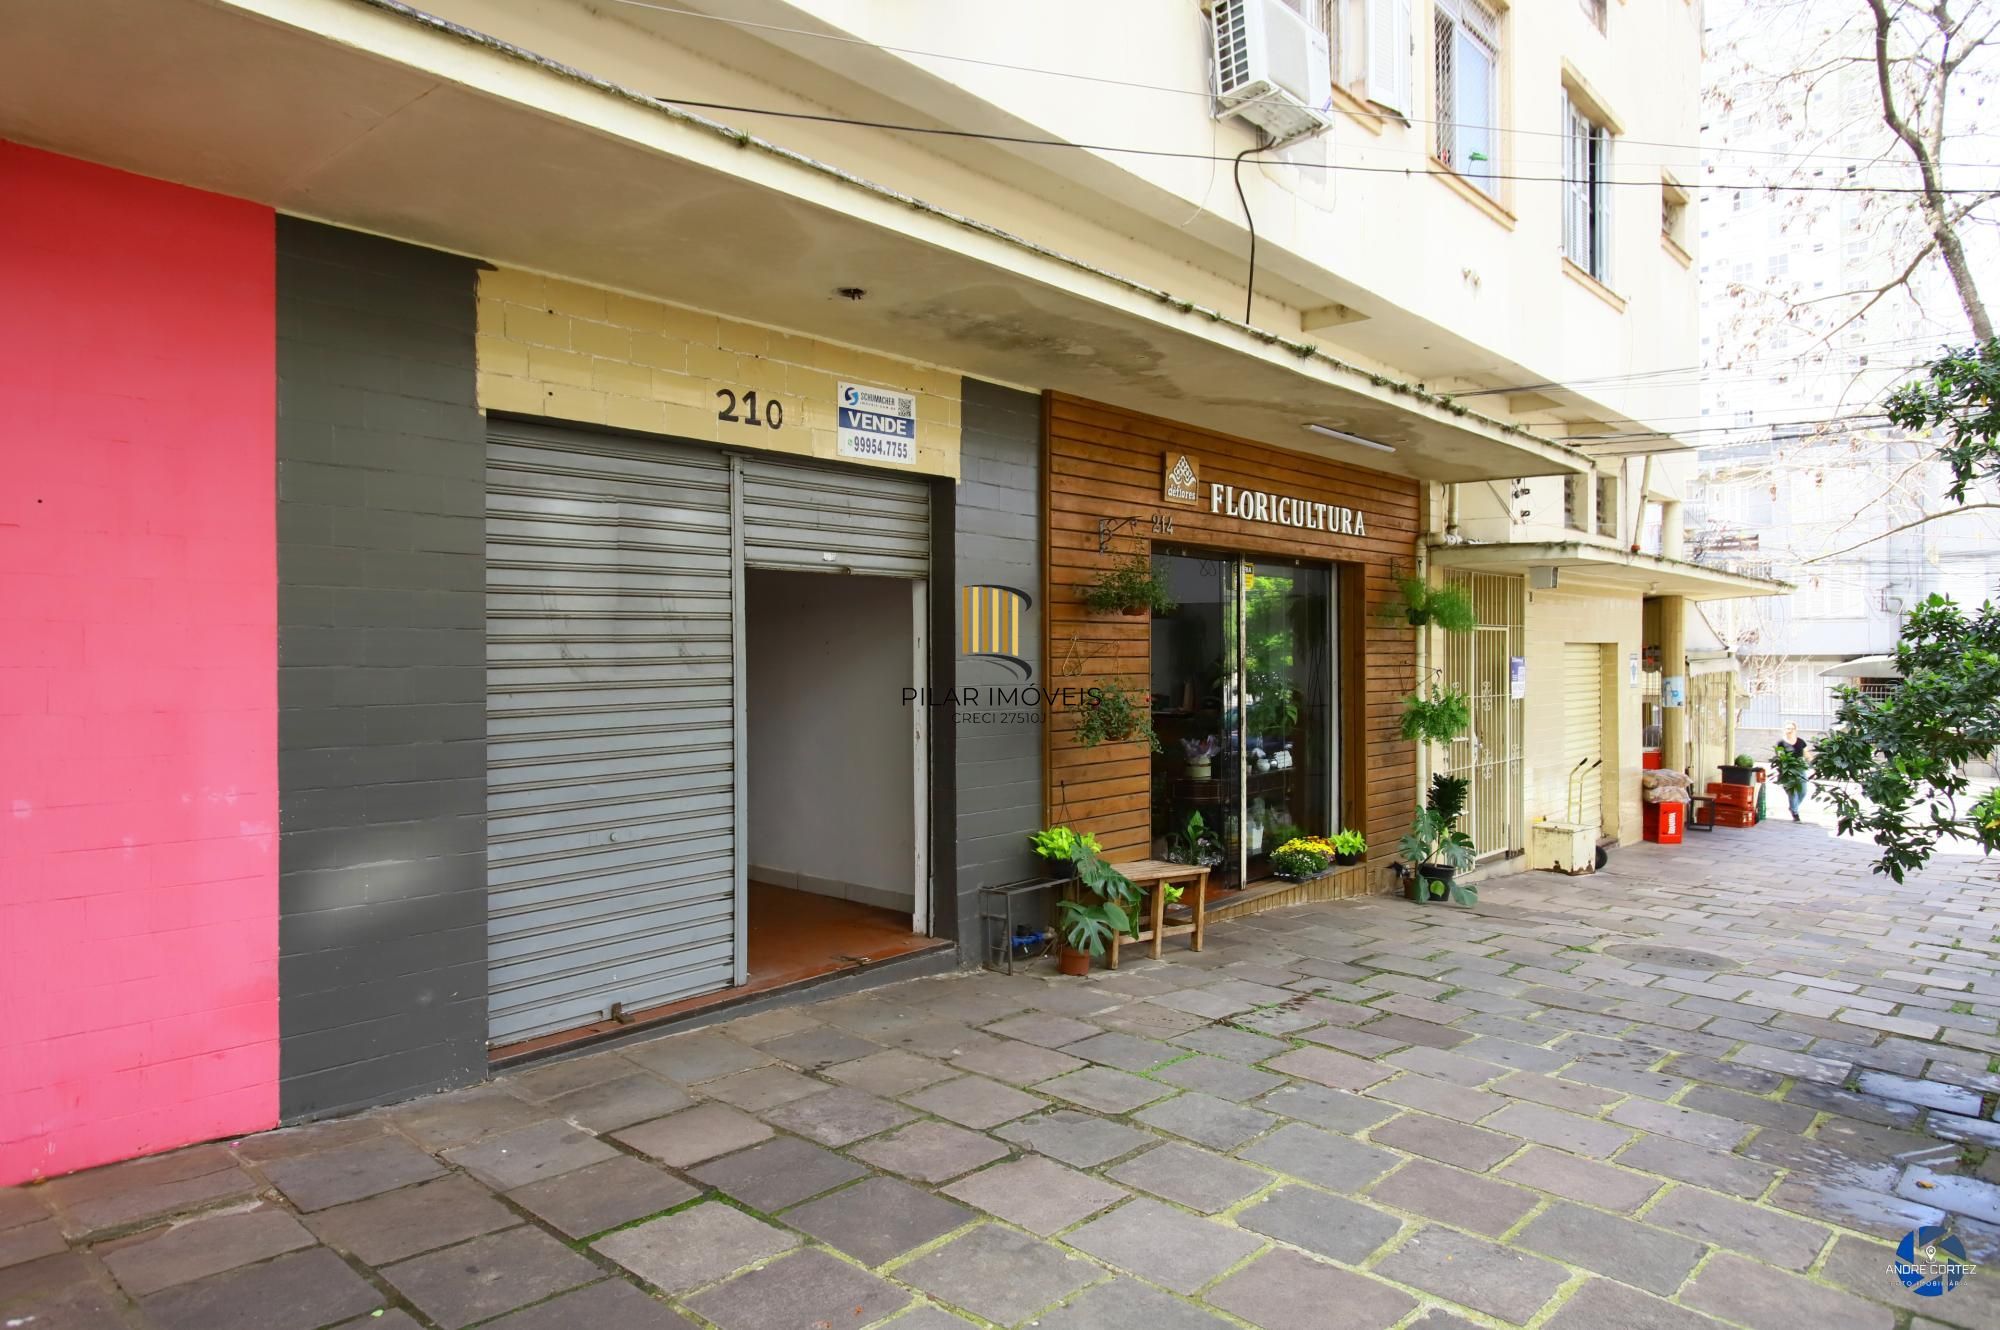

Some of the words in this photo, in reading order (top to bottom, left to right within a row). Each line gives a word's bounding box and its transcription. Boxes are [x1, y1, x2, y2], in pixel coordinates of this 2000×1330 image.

[716, 388, 783, 430] 210
[860, 391, 895, 406] SCHUMACHER
[848, 410, 907, 436] VENDE
[854, 435, 908, 459] 99954.7755
[1210, 483, 1366, 537] FLORICULTURA
[1152, 514, 1174, 534] 214
